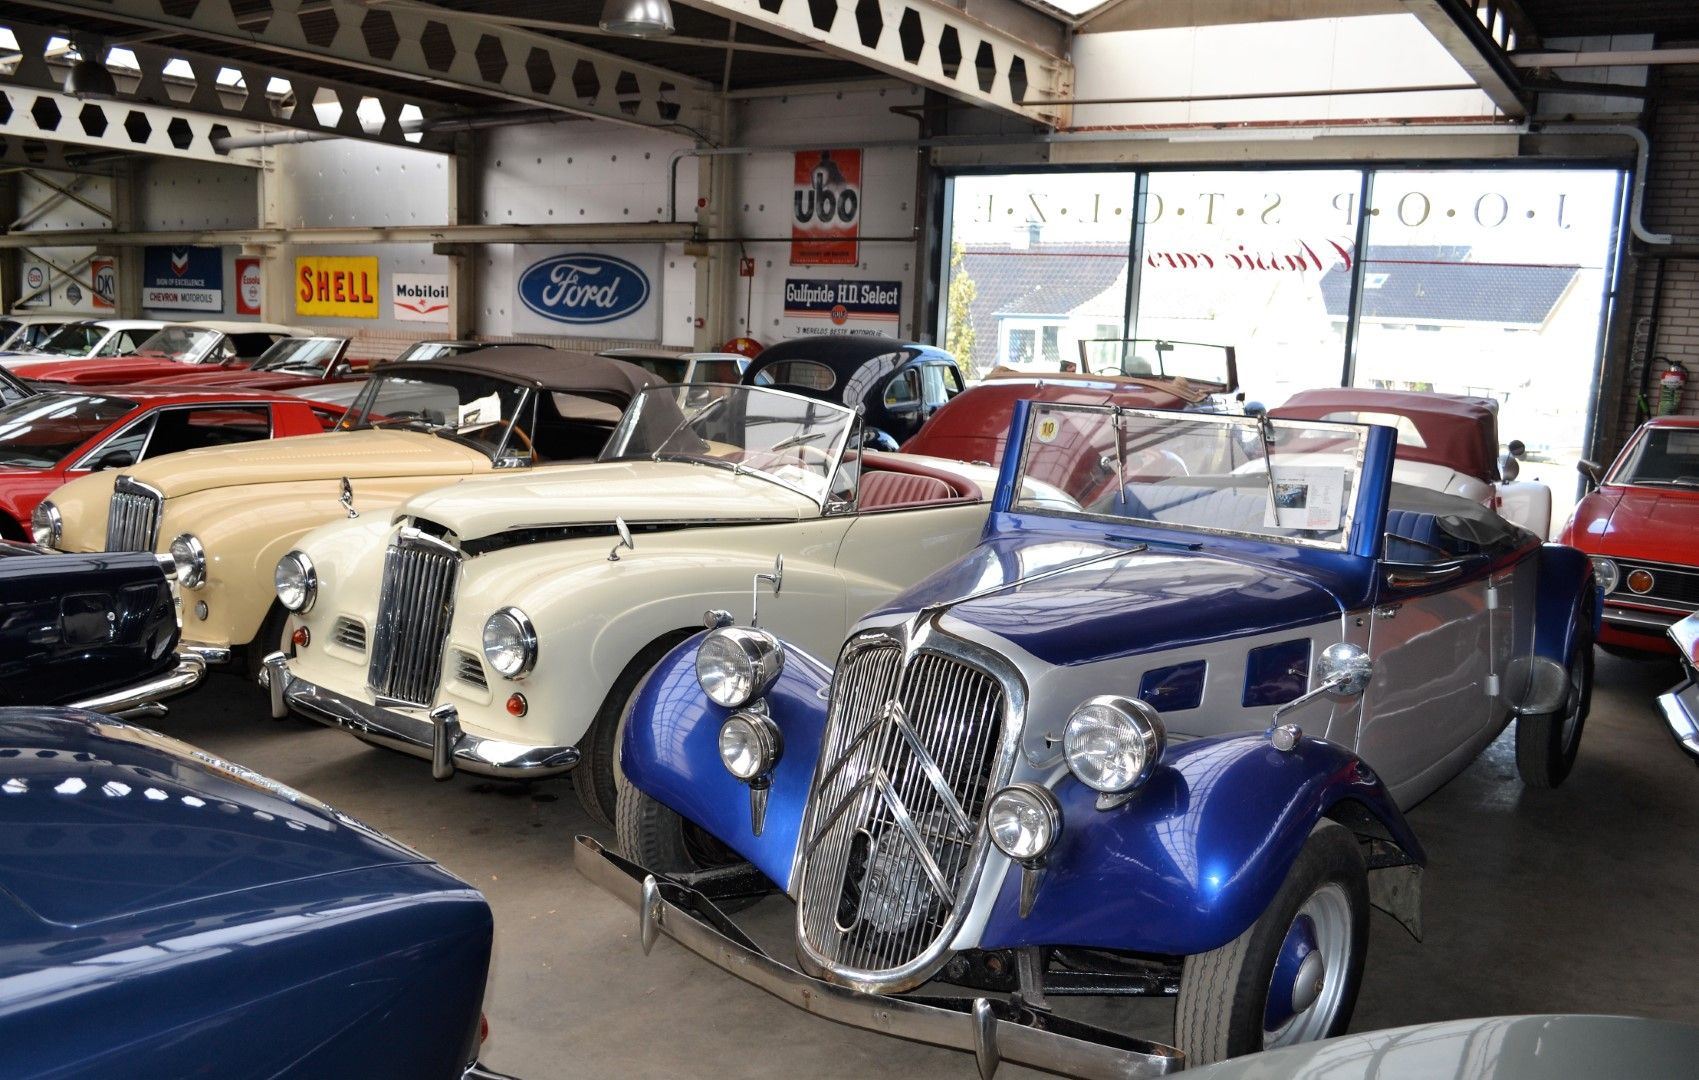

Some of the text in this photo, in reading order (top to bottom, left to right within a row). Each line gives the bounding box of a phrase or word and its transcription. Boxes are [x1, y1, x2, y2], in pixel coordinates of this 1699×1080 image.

[794, 172, 858, 223] ubo
[97, 274, 115, 295] DK
[300, 265, 374, 304] SHELL
[397, 284, 449, 298] Mobiloil
[542, 263, 621, 308] Ford
[786, 283, 898, 307] Gulfpride H.D. Select
[149, 292, 213, 303] CHEVRON MOTOROILS
[1043, 422, 1055, 434] 10
